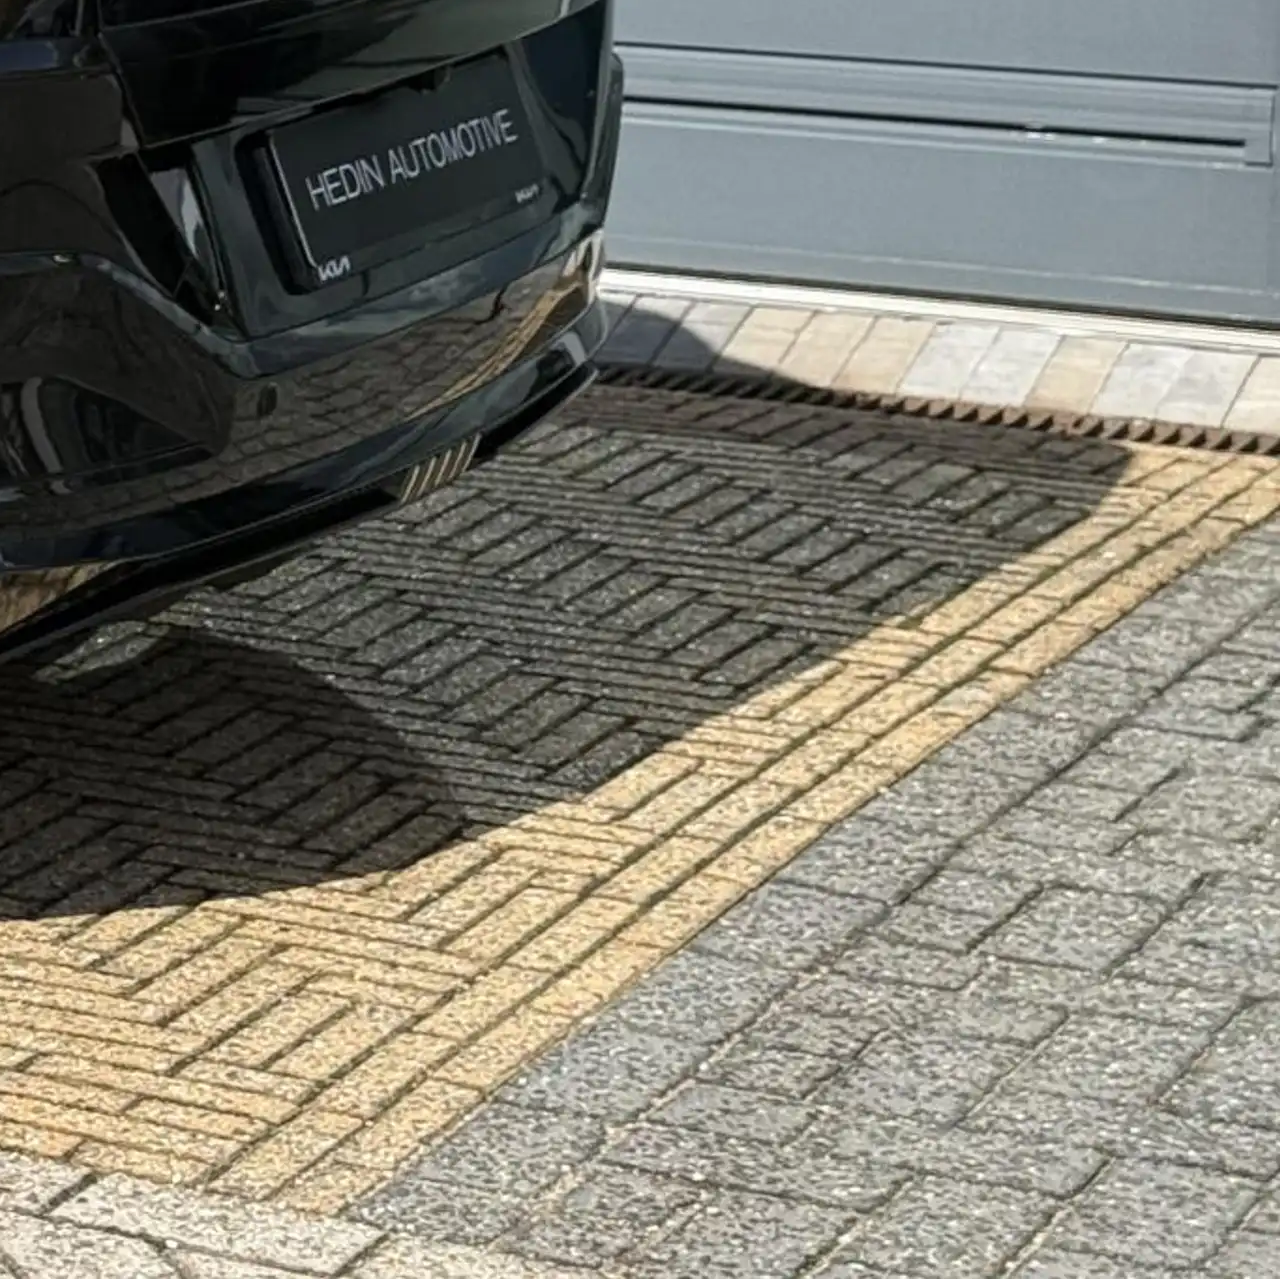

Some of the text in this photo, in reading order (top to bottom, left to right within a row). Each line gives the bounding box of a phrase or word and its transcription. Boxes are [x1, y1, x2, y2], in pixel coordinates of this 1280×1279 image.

[305, 108, 518, 210] HEDIN AUTOMOTIVE
[319, 255, 351, 283] KIA
